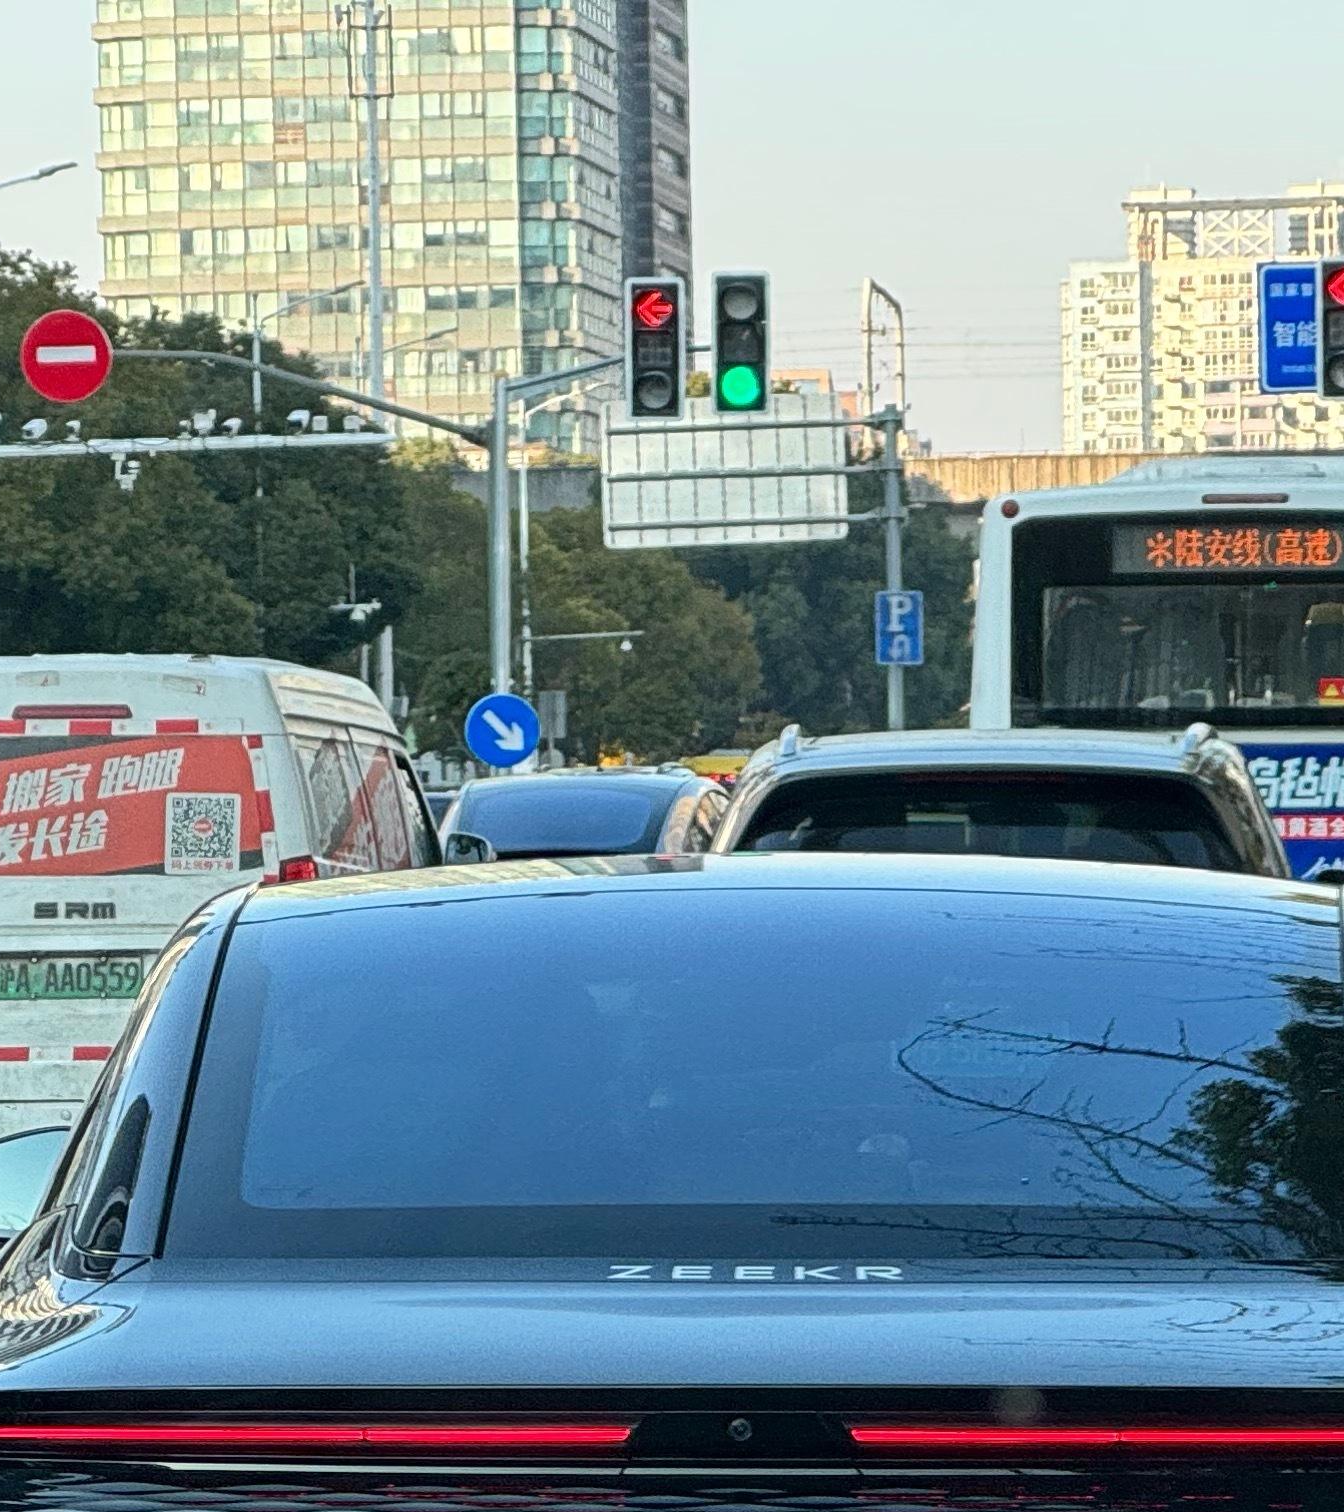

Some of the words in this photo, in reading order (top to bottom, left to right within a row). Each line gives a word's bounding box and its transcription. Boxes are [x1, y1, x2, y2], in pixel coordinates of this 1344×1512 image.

[0, 762, 94, 816] 搬家
[97, 748, 185, 798] 跑腿
[33, 901, 117, 920] SRM
[606, 1264, 905, 1282] ZEEKR
